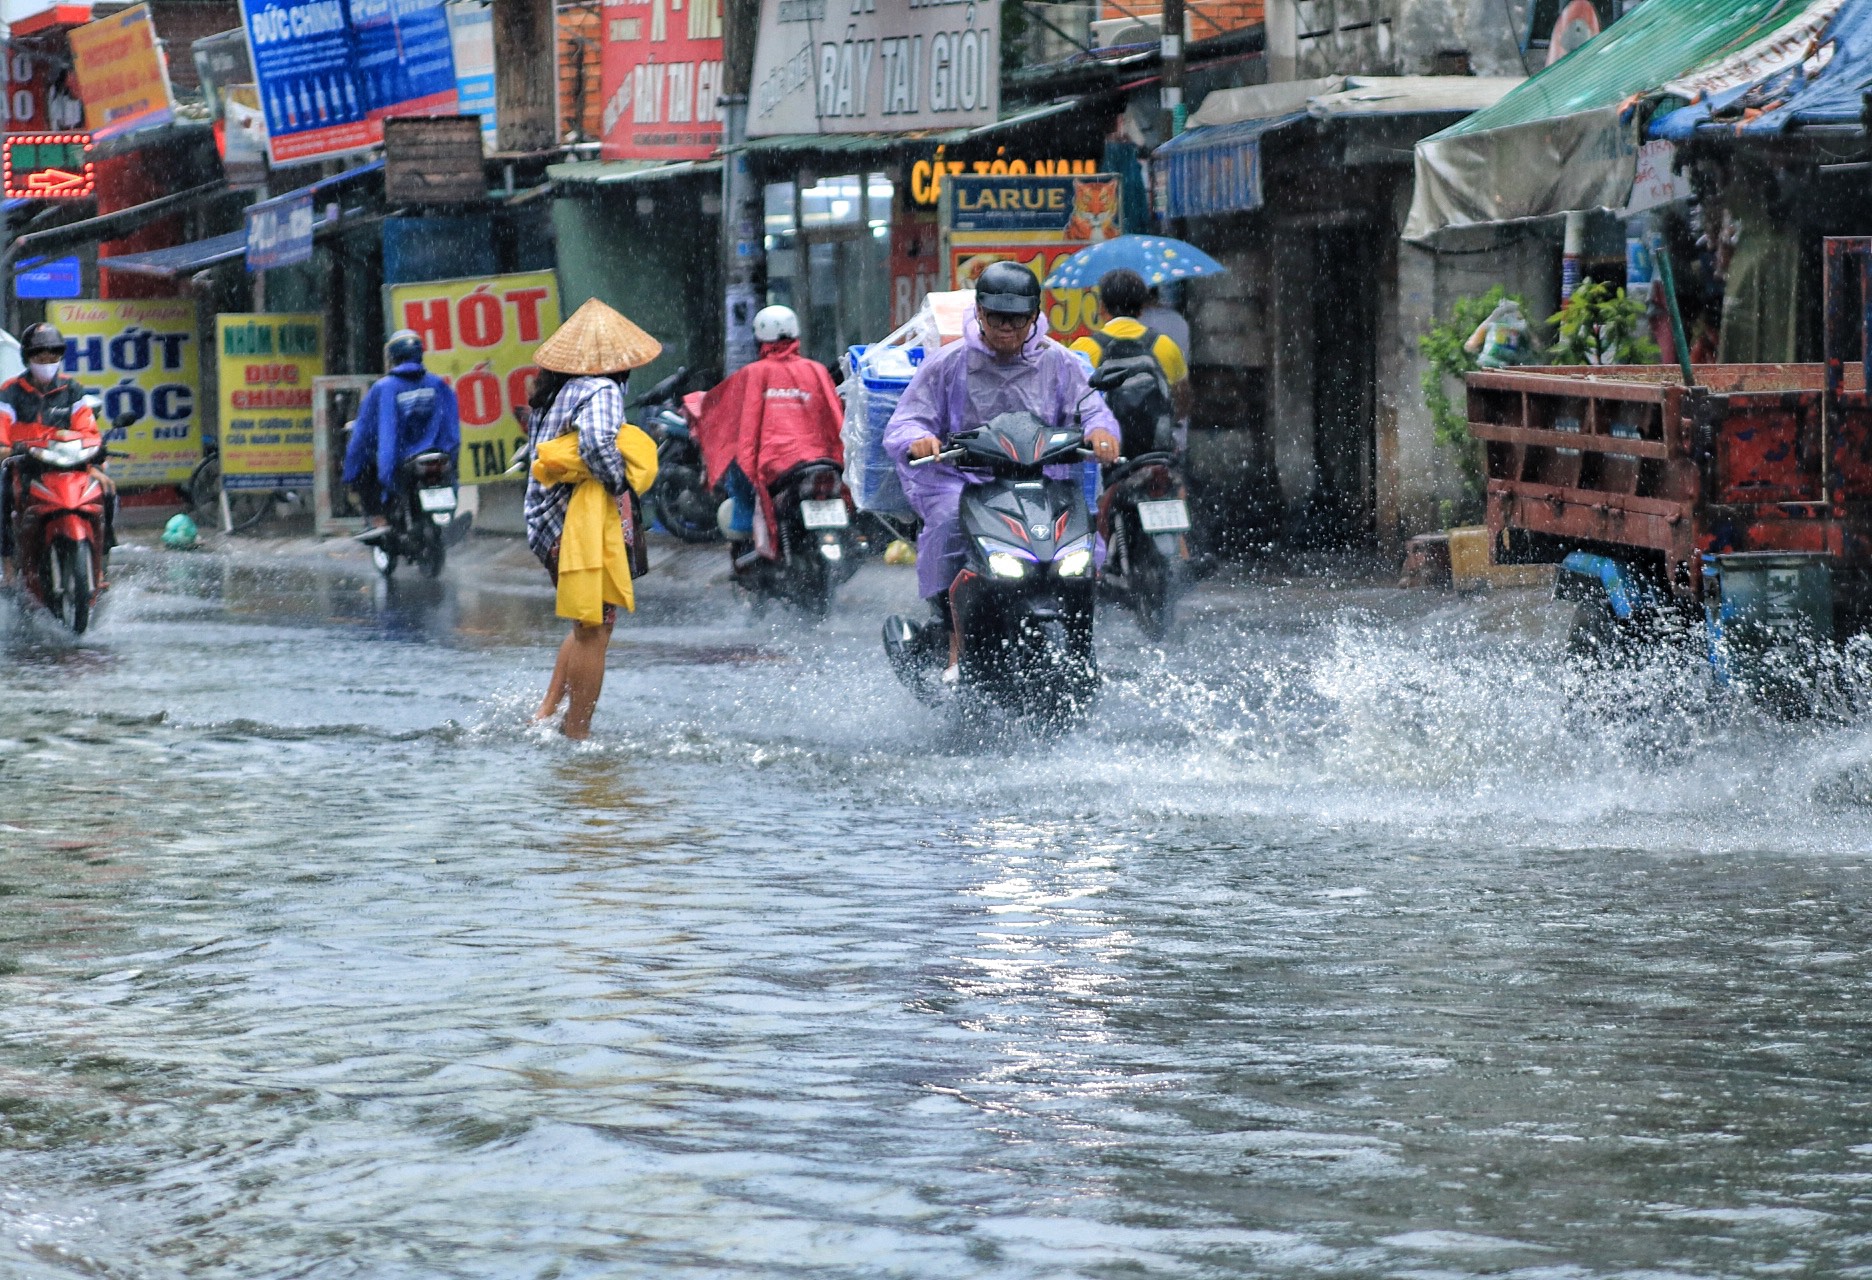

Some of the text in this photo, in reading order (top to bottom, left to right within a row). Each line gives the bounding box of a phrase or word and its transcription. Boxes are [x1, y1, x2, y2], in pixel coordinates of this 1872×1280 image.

[252, 2, 289, 44] ĐỨC
[817, 2, 990, 117] RÁY TAI GIỎI
[667, 61, 694, 122] TAI
[958, 188, 1066, 210] LARUE
[62, 326, 190, 372] HỚT
[83, 378, 193, 420] ÓC
[469, 439, 507, 477] TAI
